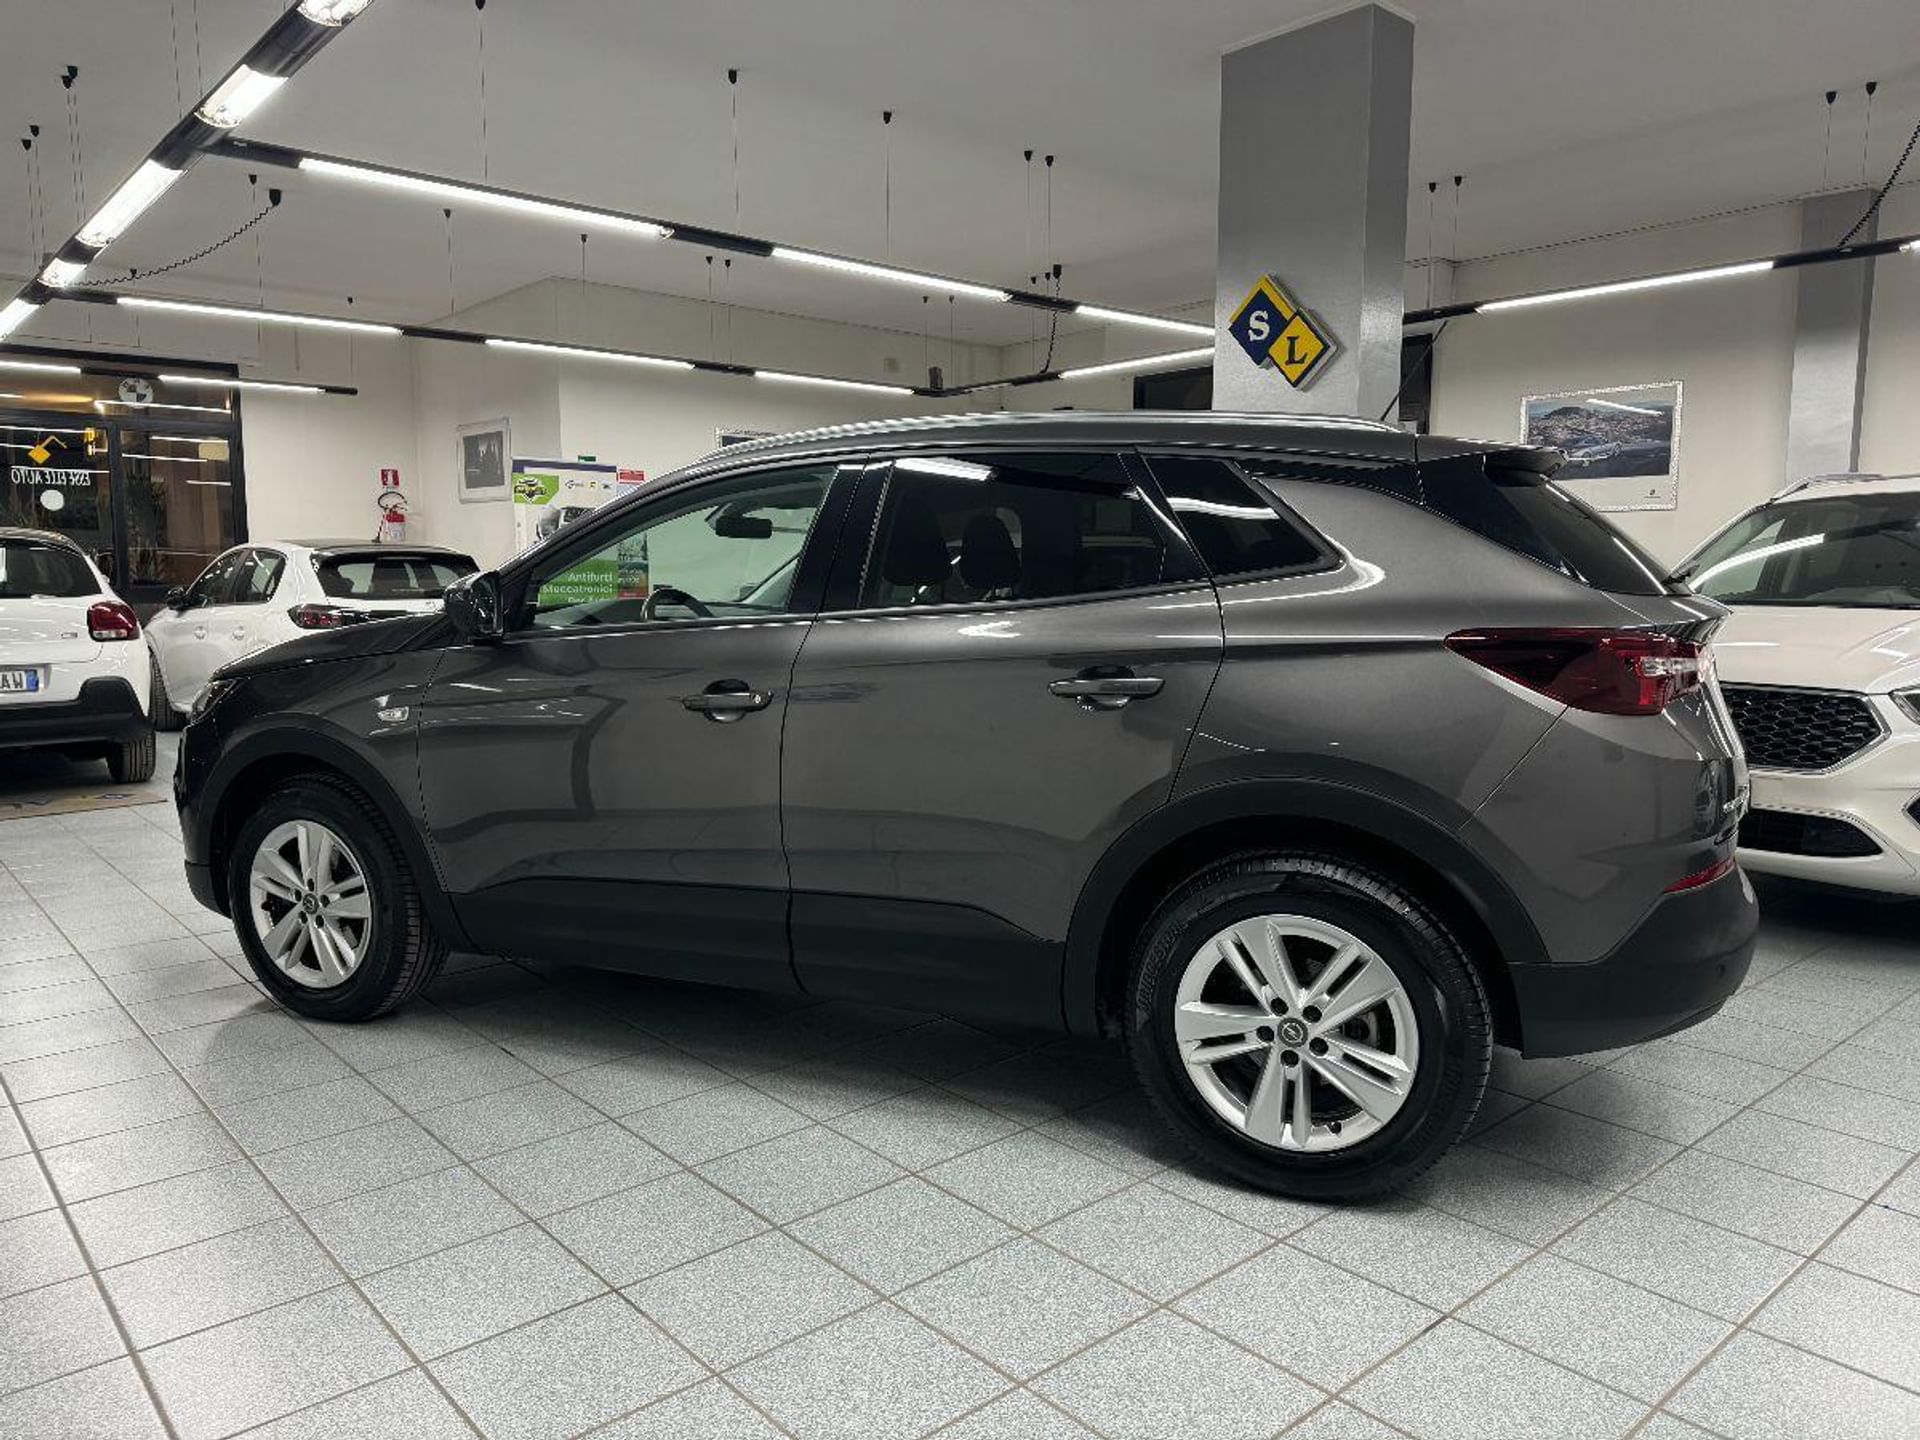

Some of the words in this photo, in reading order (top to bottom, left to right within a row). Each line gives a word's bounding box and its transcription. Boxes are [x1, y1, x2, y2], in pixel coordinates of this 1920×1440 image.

[1247, 309, 1271, 342] S
[1285, 335, 1309, 366] L
[567, 571, 613, 582] Antifurti
